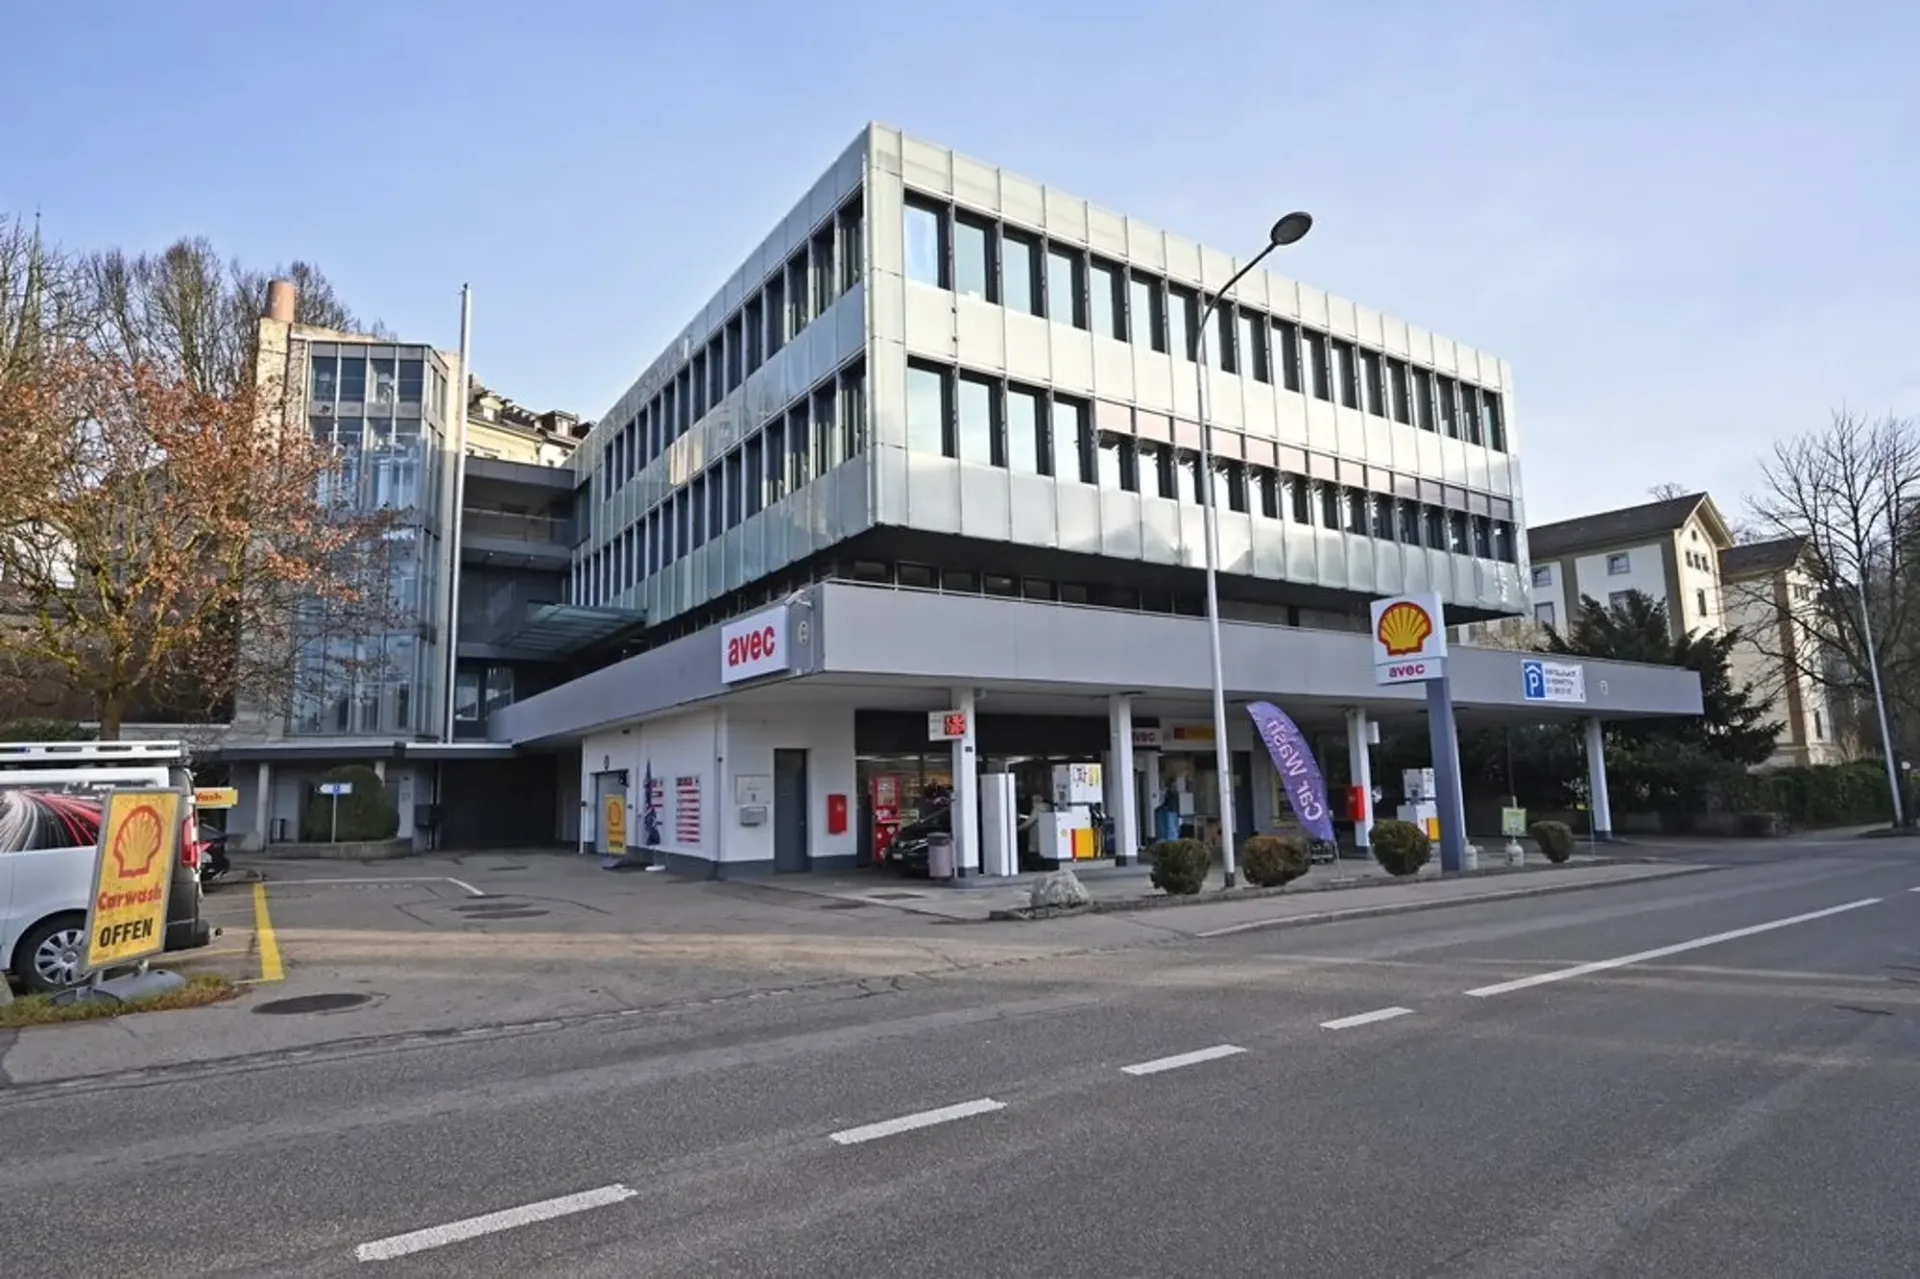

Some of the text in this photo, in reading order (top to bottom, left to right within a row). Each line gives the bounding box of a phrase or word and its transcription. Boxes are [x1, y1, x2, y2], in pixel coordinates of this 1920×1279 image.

[728, 626, 776, 666] avec
[1389, 664, 1425, 678] avec
[98, 883, 162, 910] Carwash
[98, 917, 153, 948] OFFEN
